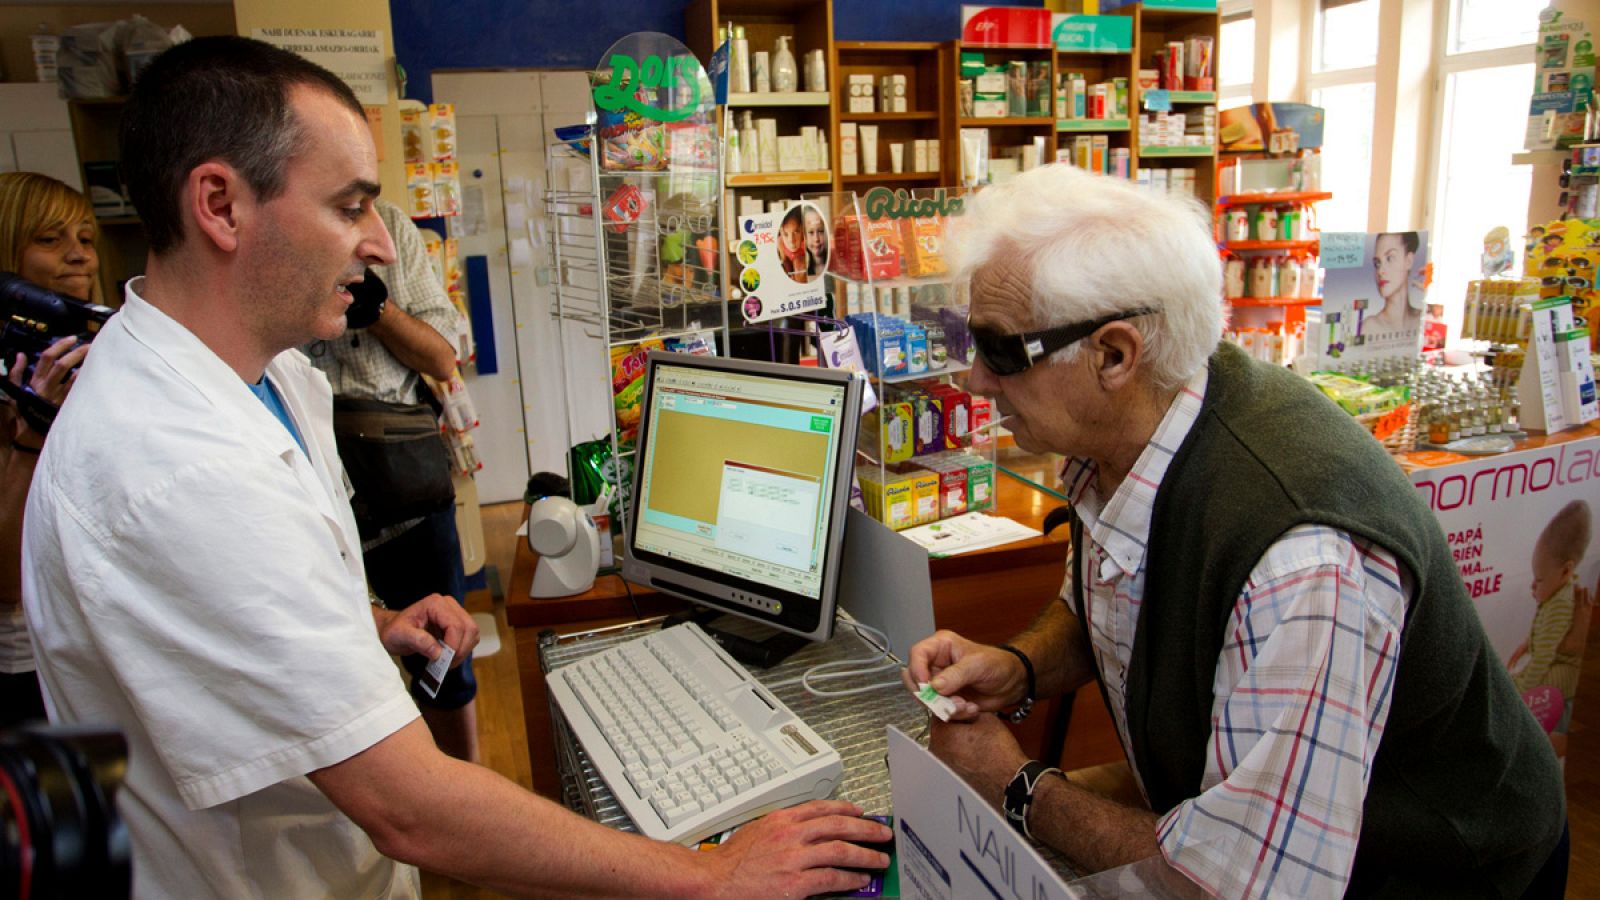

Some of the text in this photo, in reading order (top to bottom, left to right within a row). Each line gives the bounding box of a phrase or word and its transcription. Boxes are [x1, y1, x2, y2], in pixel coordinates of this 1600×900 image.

[866, 188, 964, 220] Ricola
[1415, 444, 1600, 511] normola
[1453, 542, 1484, 562] BIÉN
